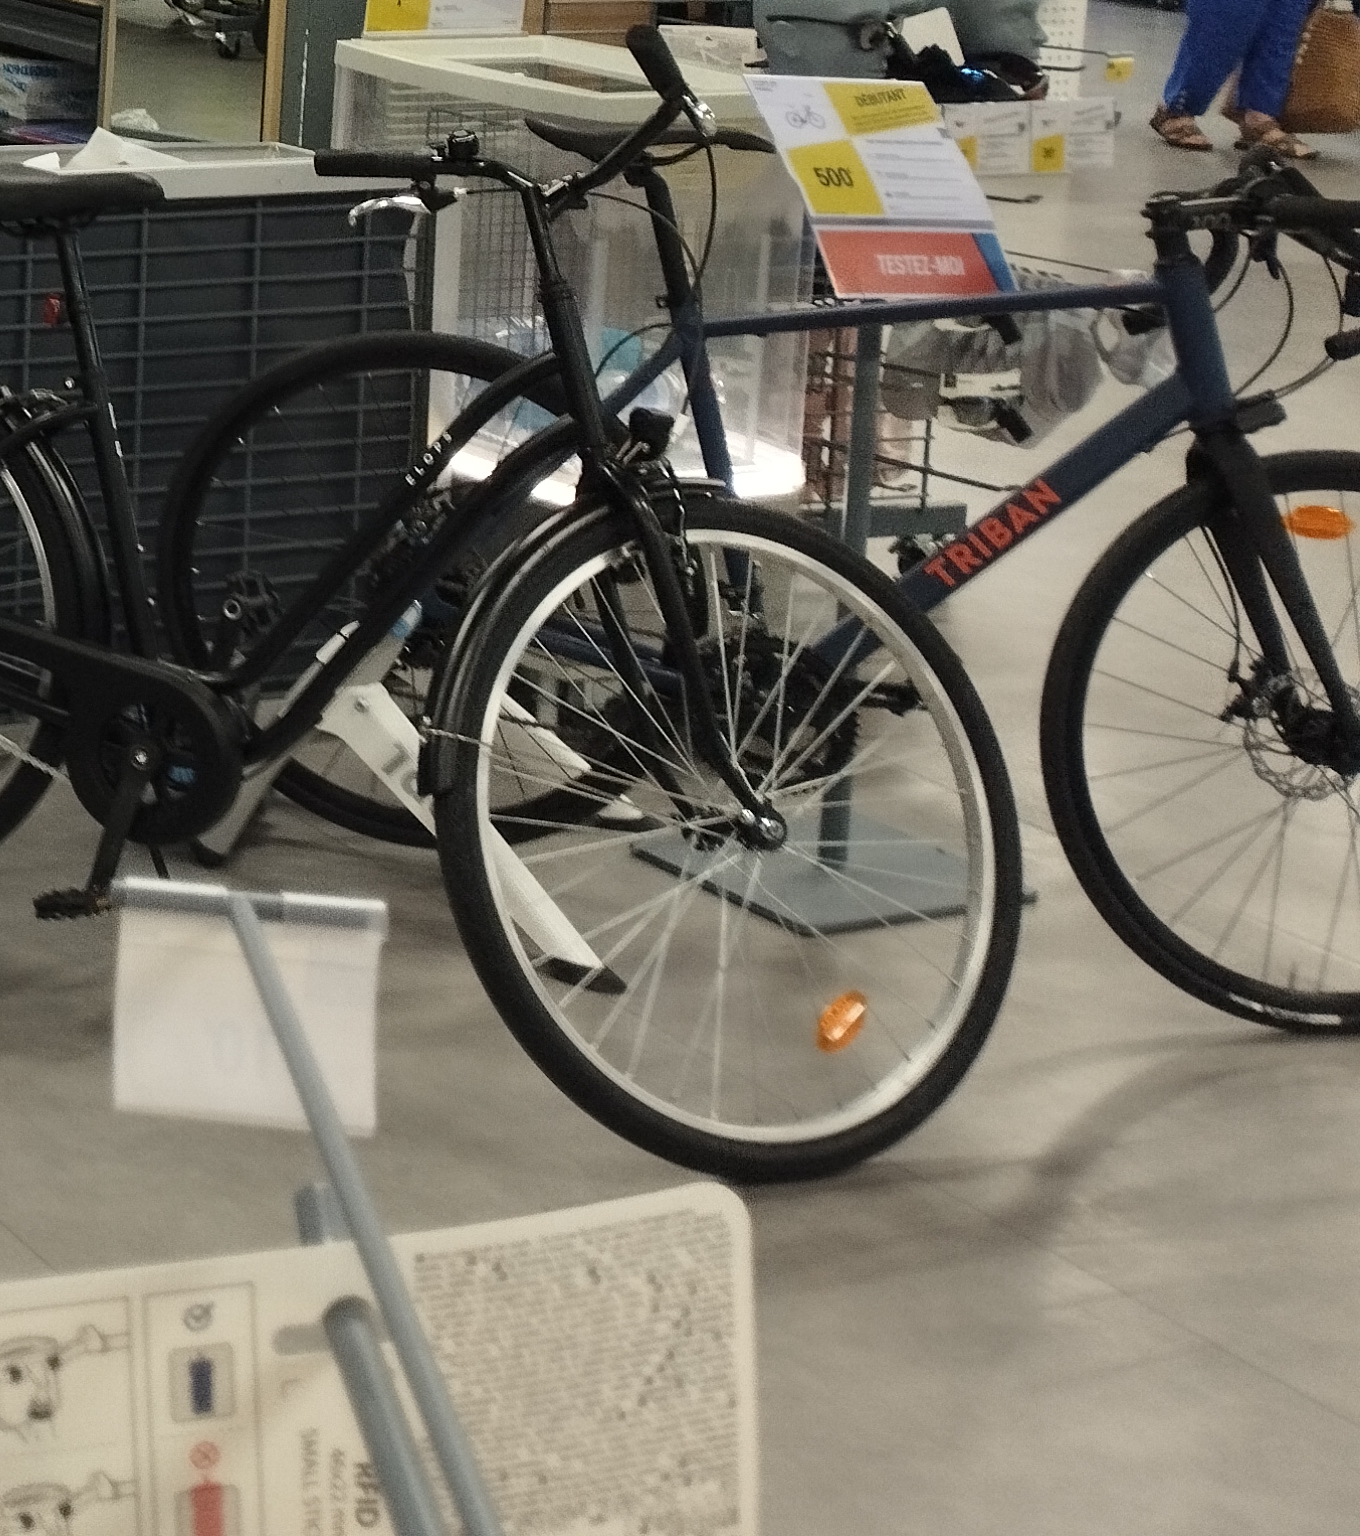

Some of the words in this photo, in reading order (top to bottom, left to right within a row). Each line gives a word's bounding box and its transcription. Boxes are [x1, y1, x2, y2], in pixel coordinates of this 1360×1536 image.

[854, 88, 908, 108] DÉBUTANT
[877, 254, 966, 276] TESTEZ-MOI
[405, 432, 453, 486] ELOPS
[923, 477, 1061, 588] TRIBAN
